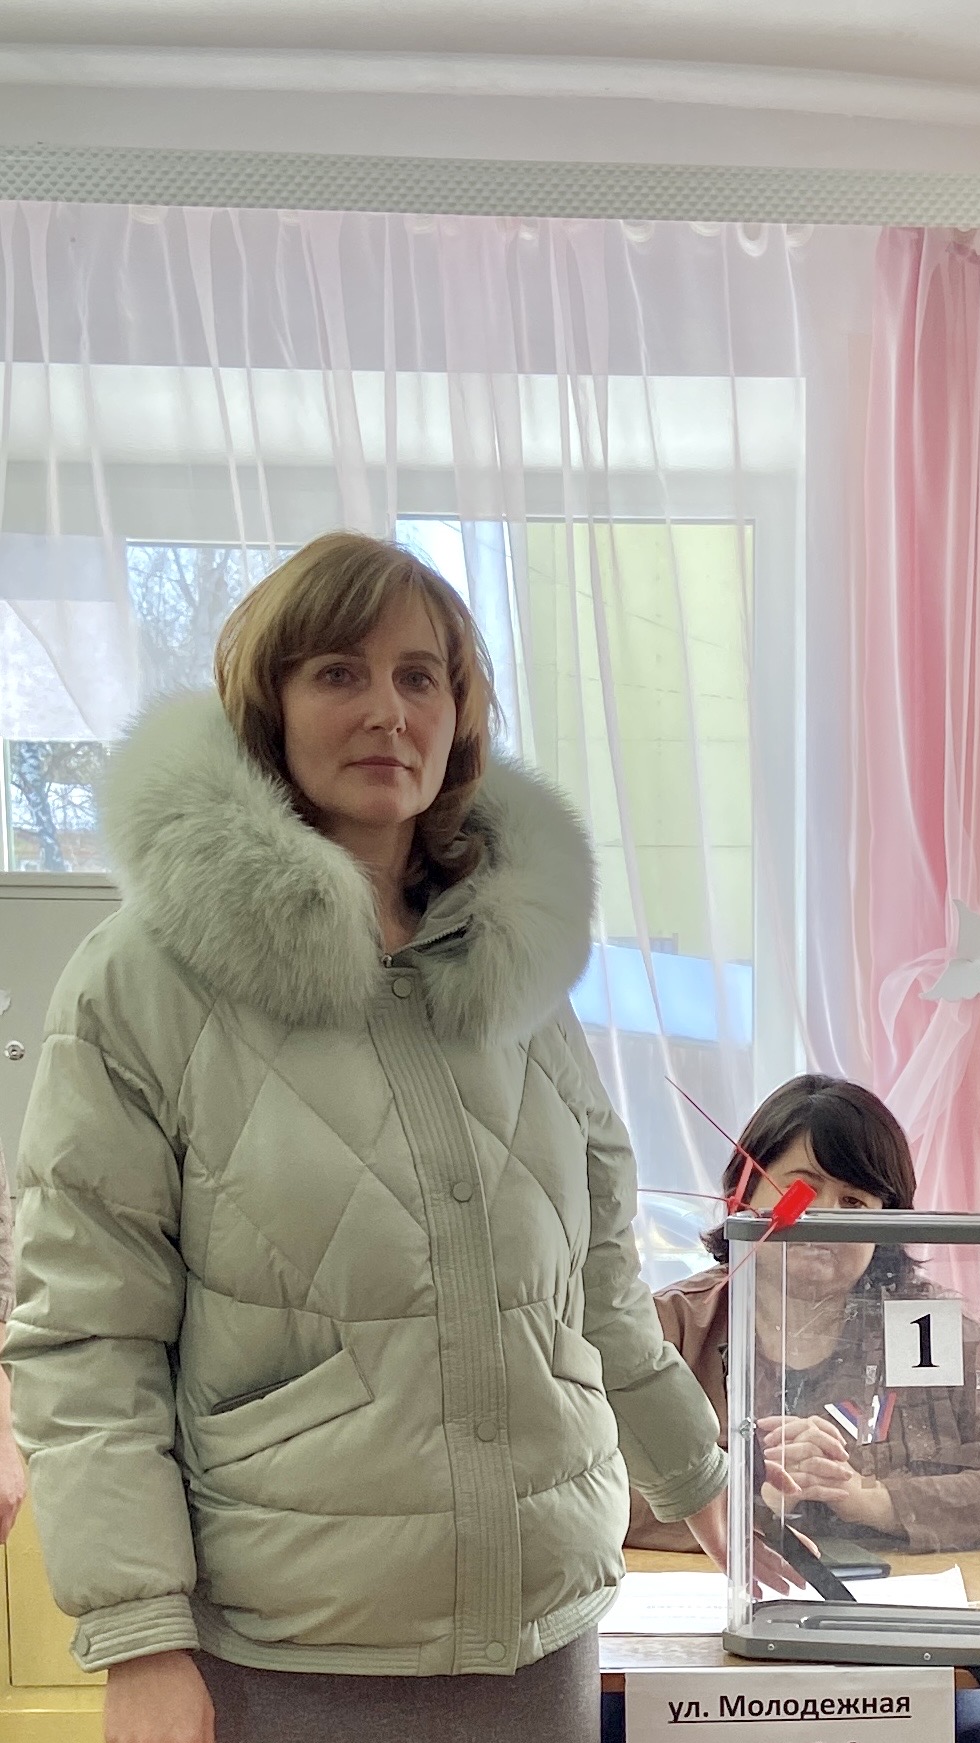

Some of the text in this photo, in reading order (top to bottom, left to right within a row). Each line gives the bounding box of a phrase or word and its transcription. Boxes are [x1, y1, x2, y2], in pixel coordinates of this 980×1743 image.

[909, 1313, 940, 1369] 1
[668, 1694, 911, 1722] ул. Молодежная
